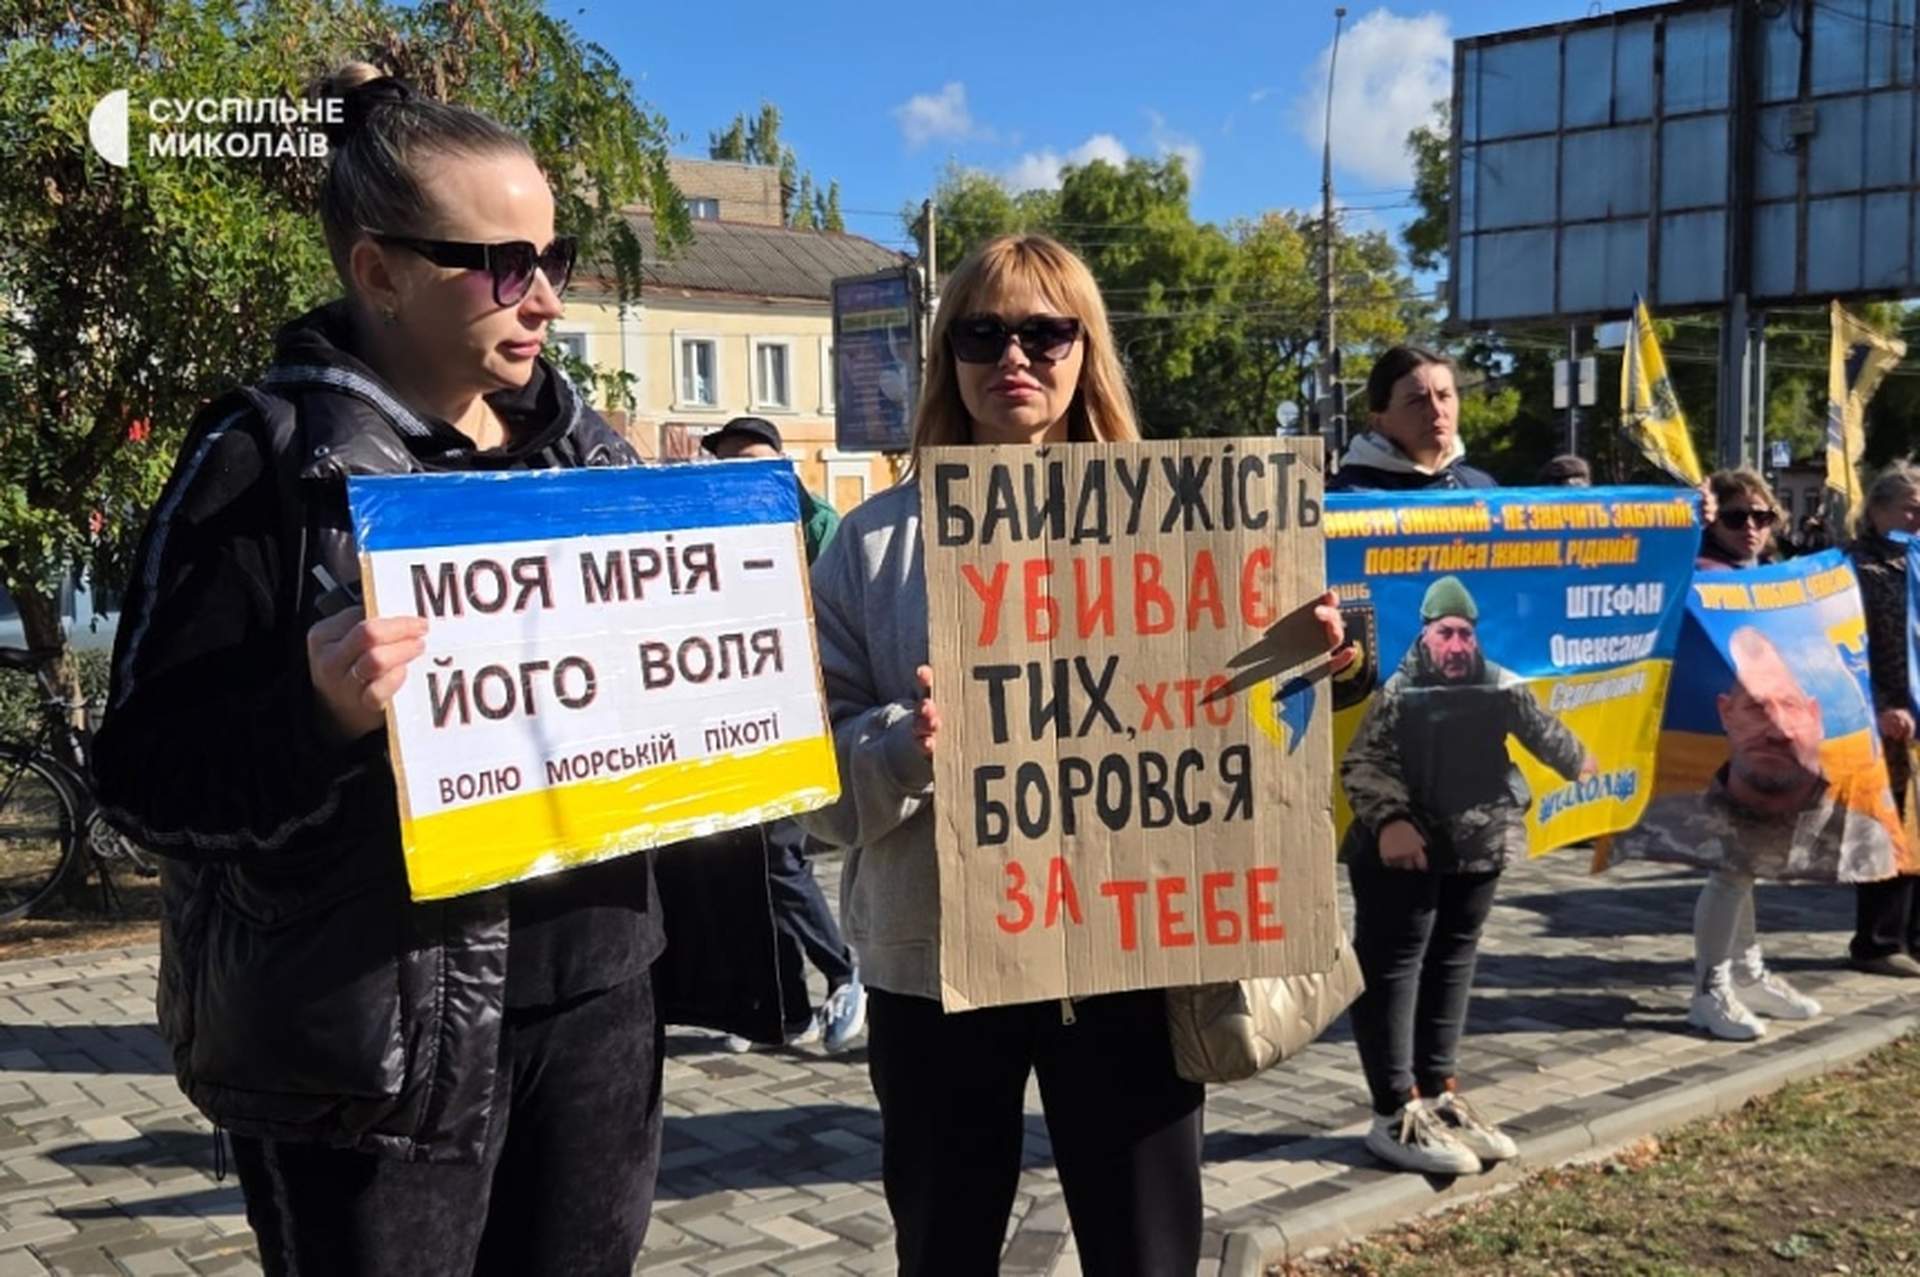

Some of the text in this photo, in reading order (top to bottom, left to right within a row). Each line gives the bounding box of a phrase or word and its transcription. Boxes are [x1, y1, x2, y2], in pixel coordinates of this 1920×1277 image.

[1502, 504, 1526, 531] НЕ
[1527, 503, 1610, 531] ЗНАЧИТЬ
[411, 555, 554, 619] МОЯ
[1364, 538, 1489, 575] ПОВЕРТАЙСЯ
[961, 546, 1278, 647] УБИВАЄ
[1566, 582, 1664, 619] ШТЕФАН
[427, 628, 784, 728] ЙОГО ВОЛЯ
[973, 655, 1235, 744] ТИХ, ХТО
[439, 766, 521, 804] ВОЛЮ
[974, 744, 1253, 846] БОРОВСЯ
[996, 857, 1285, 952] ЗА ТЕБЕ
